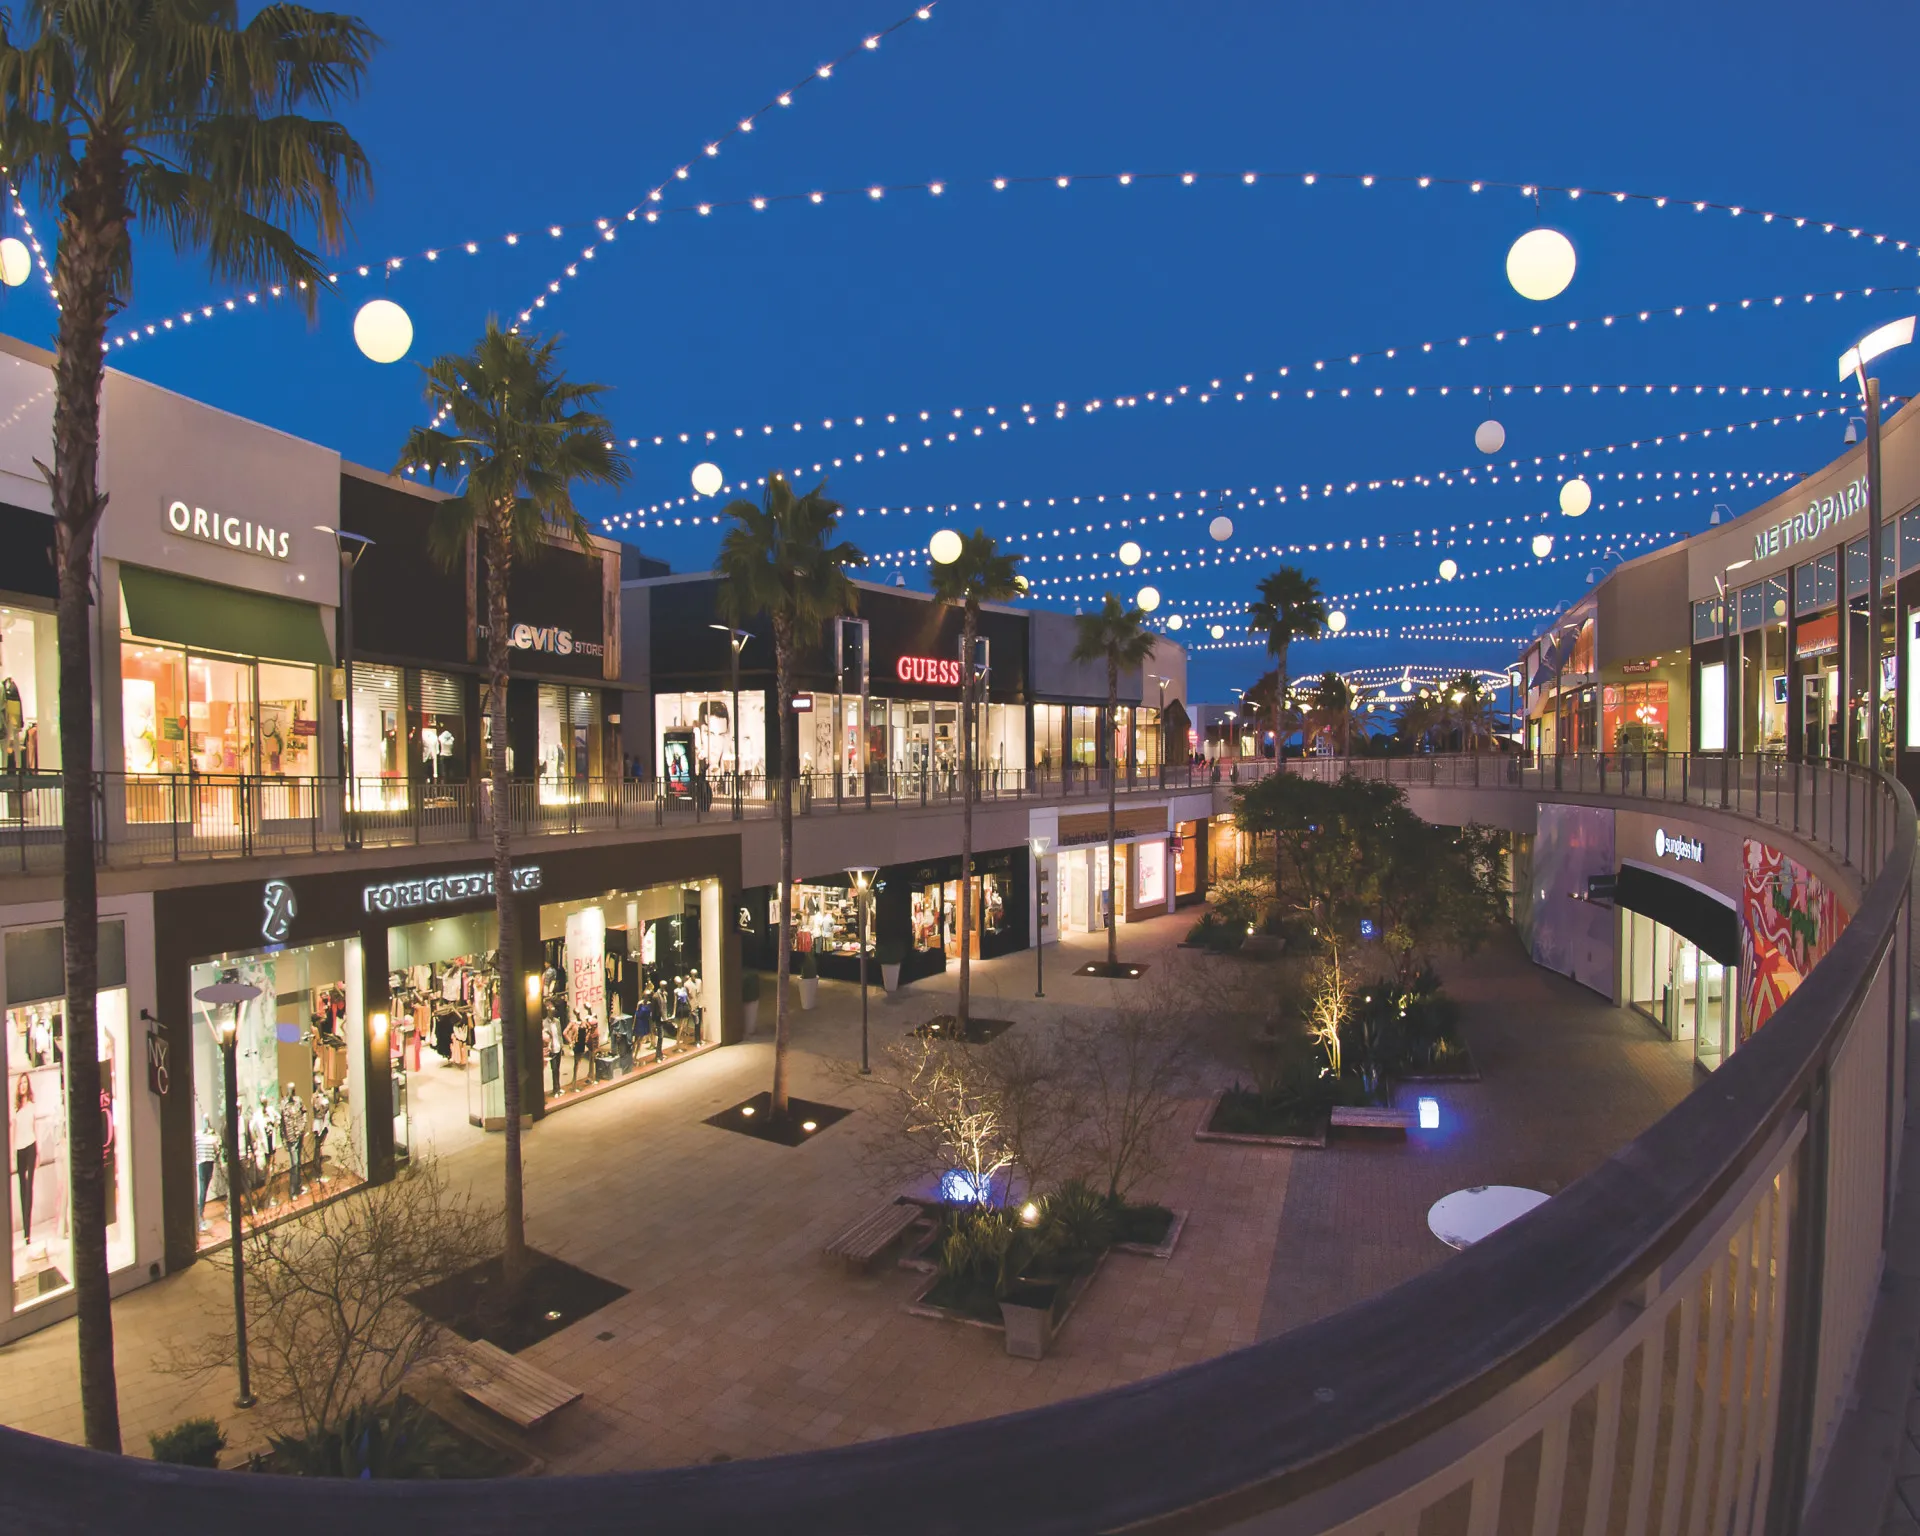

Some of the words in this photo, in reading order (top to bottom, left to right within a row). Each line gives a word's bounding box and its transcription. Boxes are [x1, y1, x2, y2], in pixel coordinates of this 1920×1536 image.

[168, 501, 290, 558] ORIGINS
[574, 641, 604, 657] STORE
[897, 655, 960, 685] GUESS
[1665, 835, 1691, 861] sunglass
[1690, 838, 1702, 863] hut
[574, 956, 594, 974] BUY
[575, 971, 595, 990] GET
[575, 985, 603, 1006] FREE
